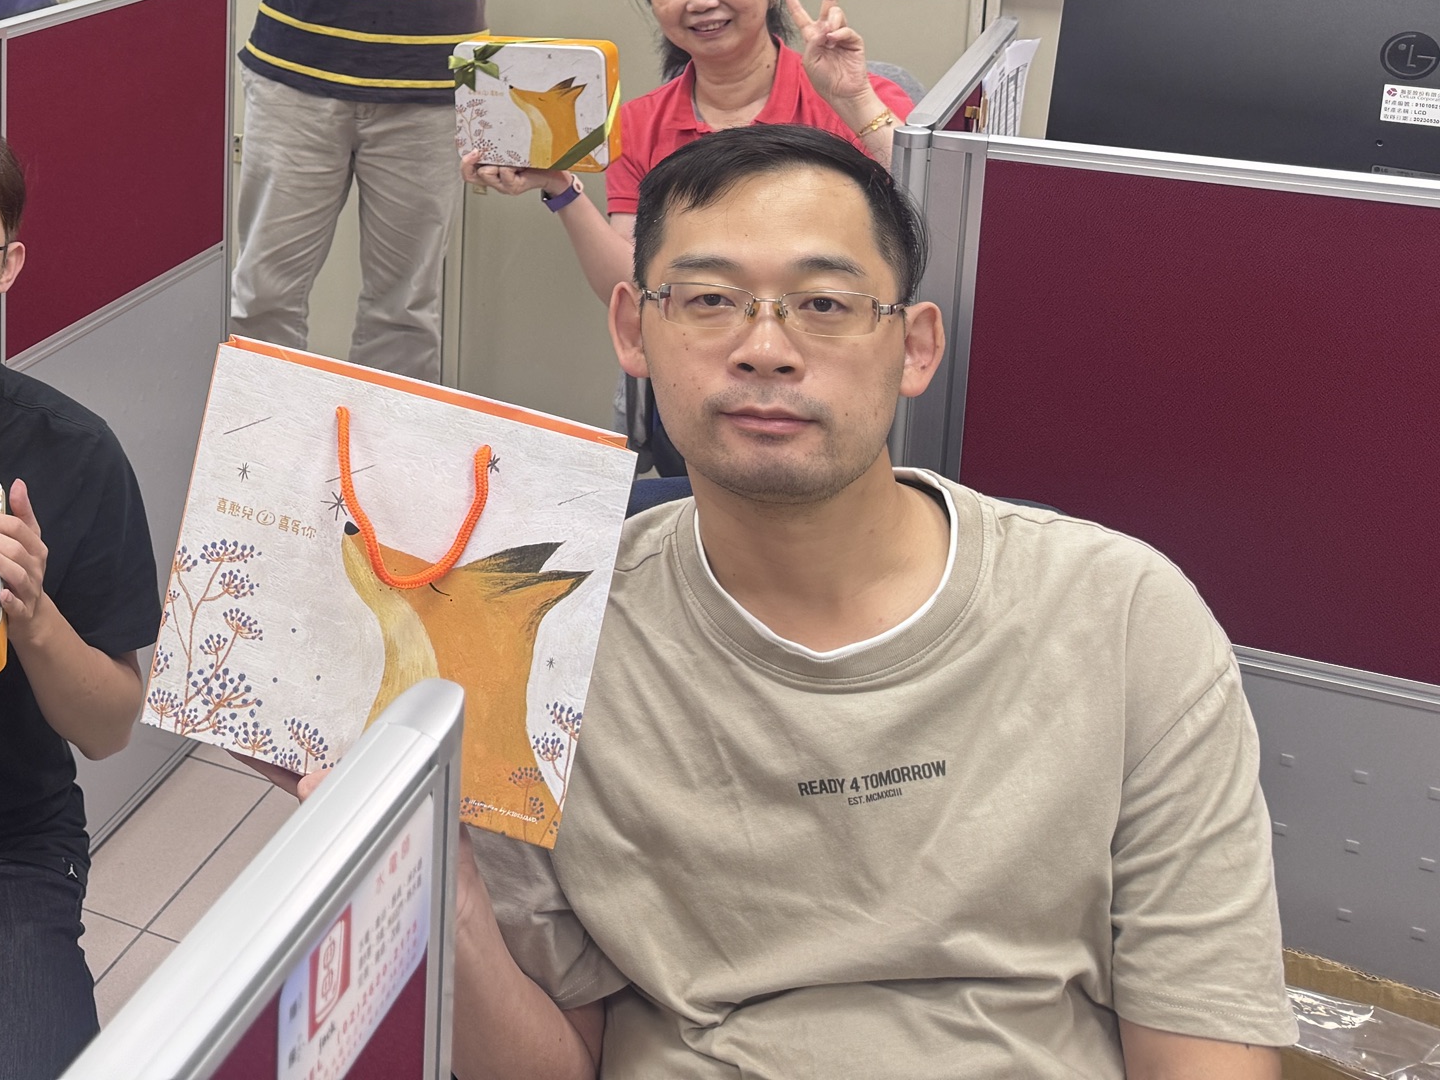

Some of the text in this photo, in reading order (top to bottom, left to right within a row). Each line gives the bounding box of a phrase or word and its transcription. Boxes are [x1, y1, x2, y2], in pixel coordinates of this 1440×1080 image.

[216, 497, 254, 521] 喜憨兒
[798, 759, 947, 797] READY 4 TOMORROW
[847, 787, 903, 806] EST. MCMXCIII
